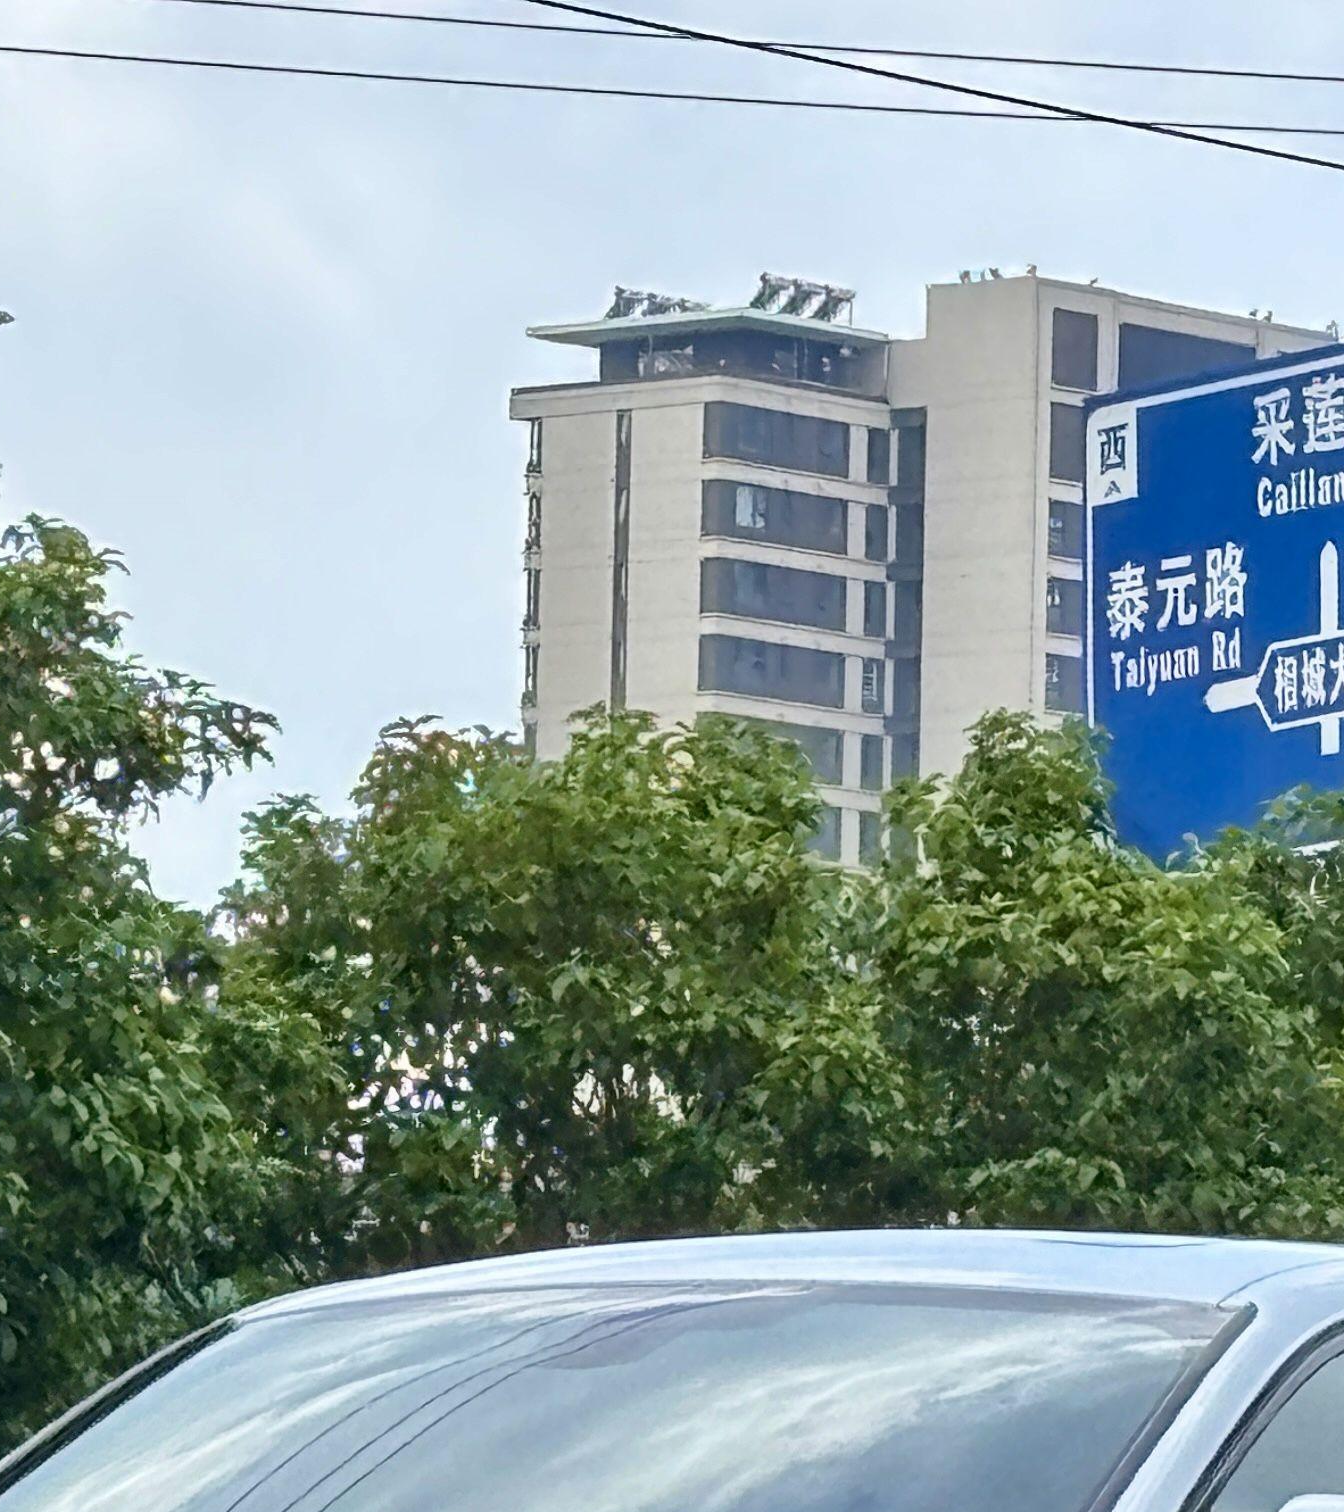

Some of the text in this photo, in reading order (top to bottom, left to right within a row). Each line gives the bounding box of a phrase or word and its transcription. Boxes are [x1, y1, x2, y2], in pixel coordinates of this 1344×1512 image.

[1097, 422, 1129, 475] 西
[1106, 541, 1248, 641] 泰元路
[1111, 627, 1241, 696] Taiyuan Rd
